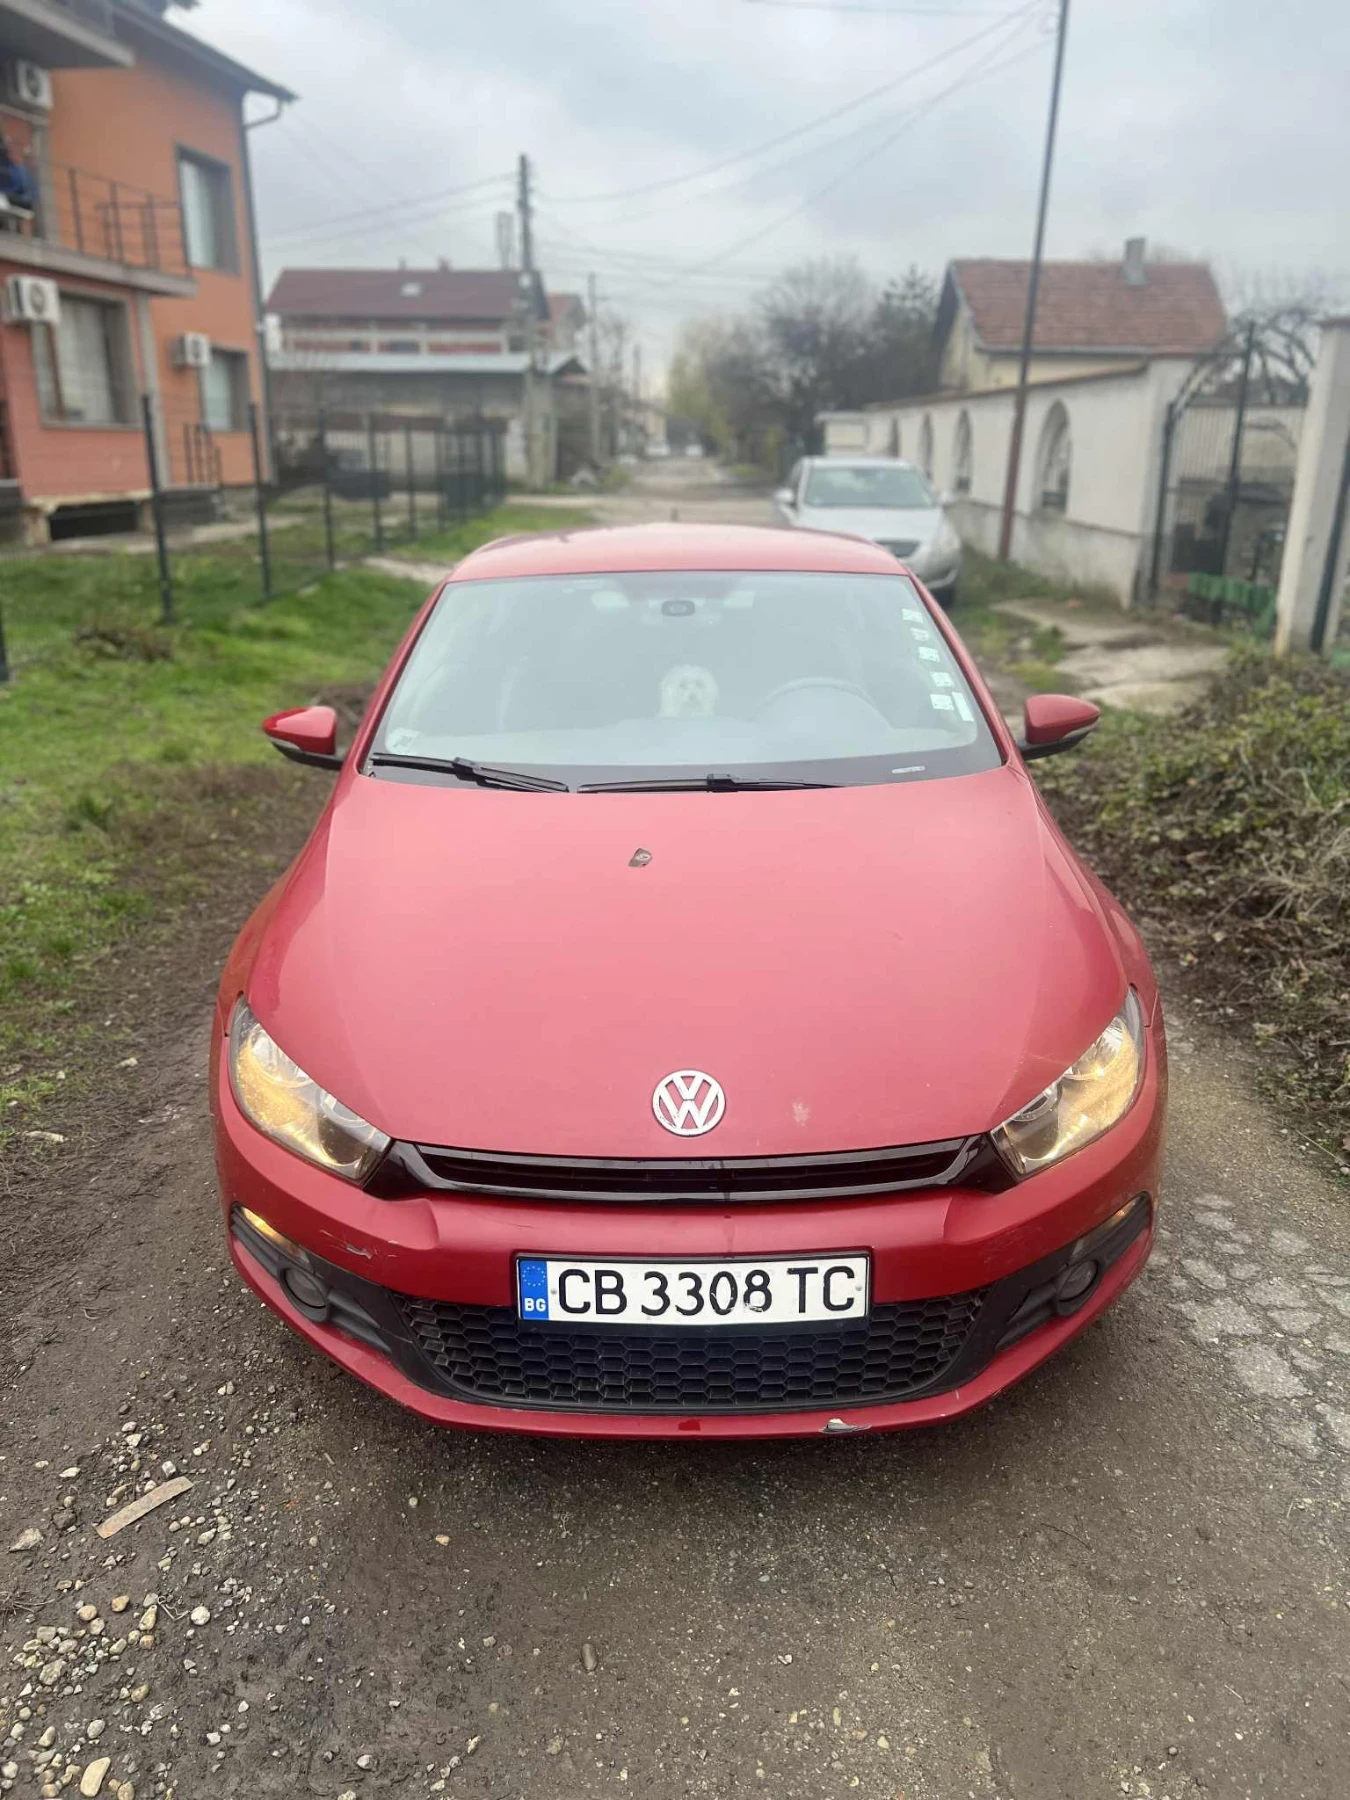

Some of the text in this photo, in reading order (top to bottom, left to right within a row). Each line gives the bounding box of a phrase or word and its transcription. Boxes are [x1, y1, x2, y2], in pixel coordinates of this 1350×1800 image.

[653, 1070, 726, 1136] VW
[524, 1298, 547, 1312] BG
[558, 1266, 855, 1316] CB 3308 TC
